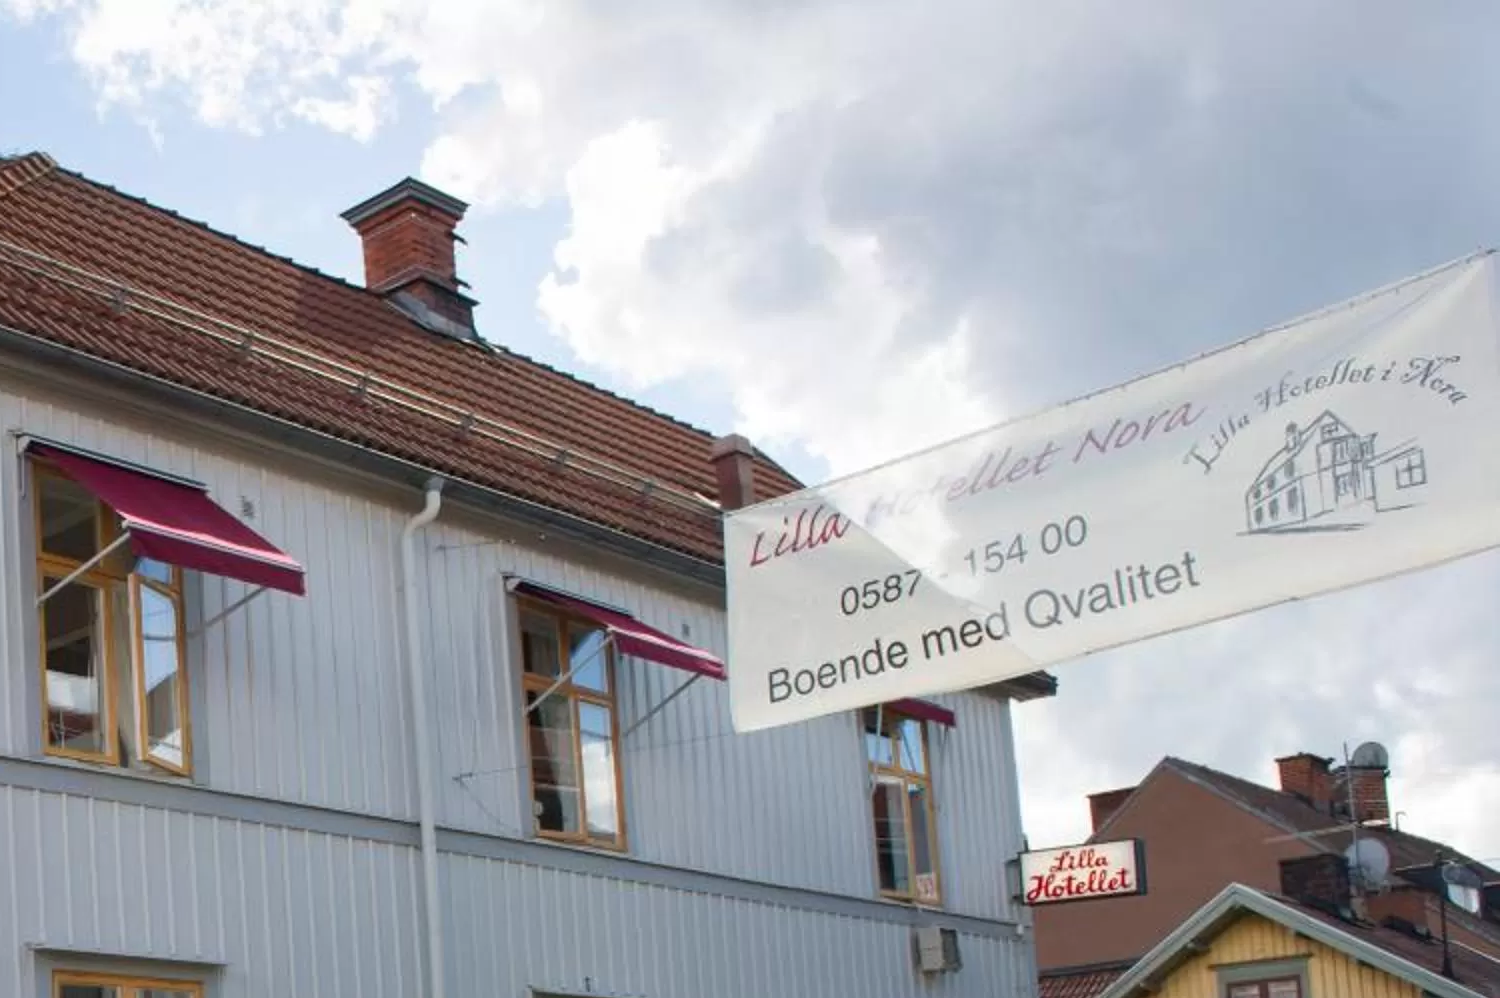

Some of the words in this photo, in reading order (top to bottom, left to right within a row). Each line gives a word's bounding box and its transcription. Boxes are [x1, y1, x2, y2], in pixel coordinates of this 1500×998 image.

[1186, 412, 1251, 475] Lilla
[1381, 360, 1398, 381] i
[1402, 354, 1469, 405] Nora
[749, 503, 851, 566] Lilla
[1072, 400, 1208, 465] Nora
[839, 569, 923, 616] 0587
[963, 533, 1028, 577] 154
[1040, 514, 1088, 555] 00
[768, 638, 909, 702] Boende
[920, 601, 1011, 660] med
[1024, 551, 1201, 629] Qvalitet
[1026, 867, 1132, 906] Hotellet
[1049, 848, 1108, 873] Lilla
